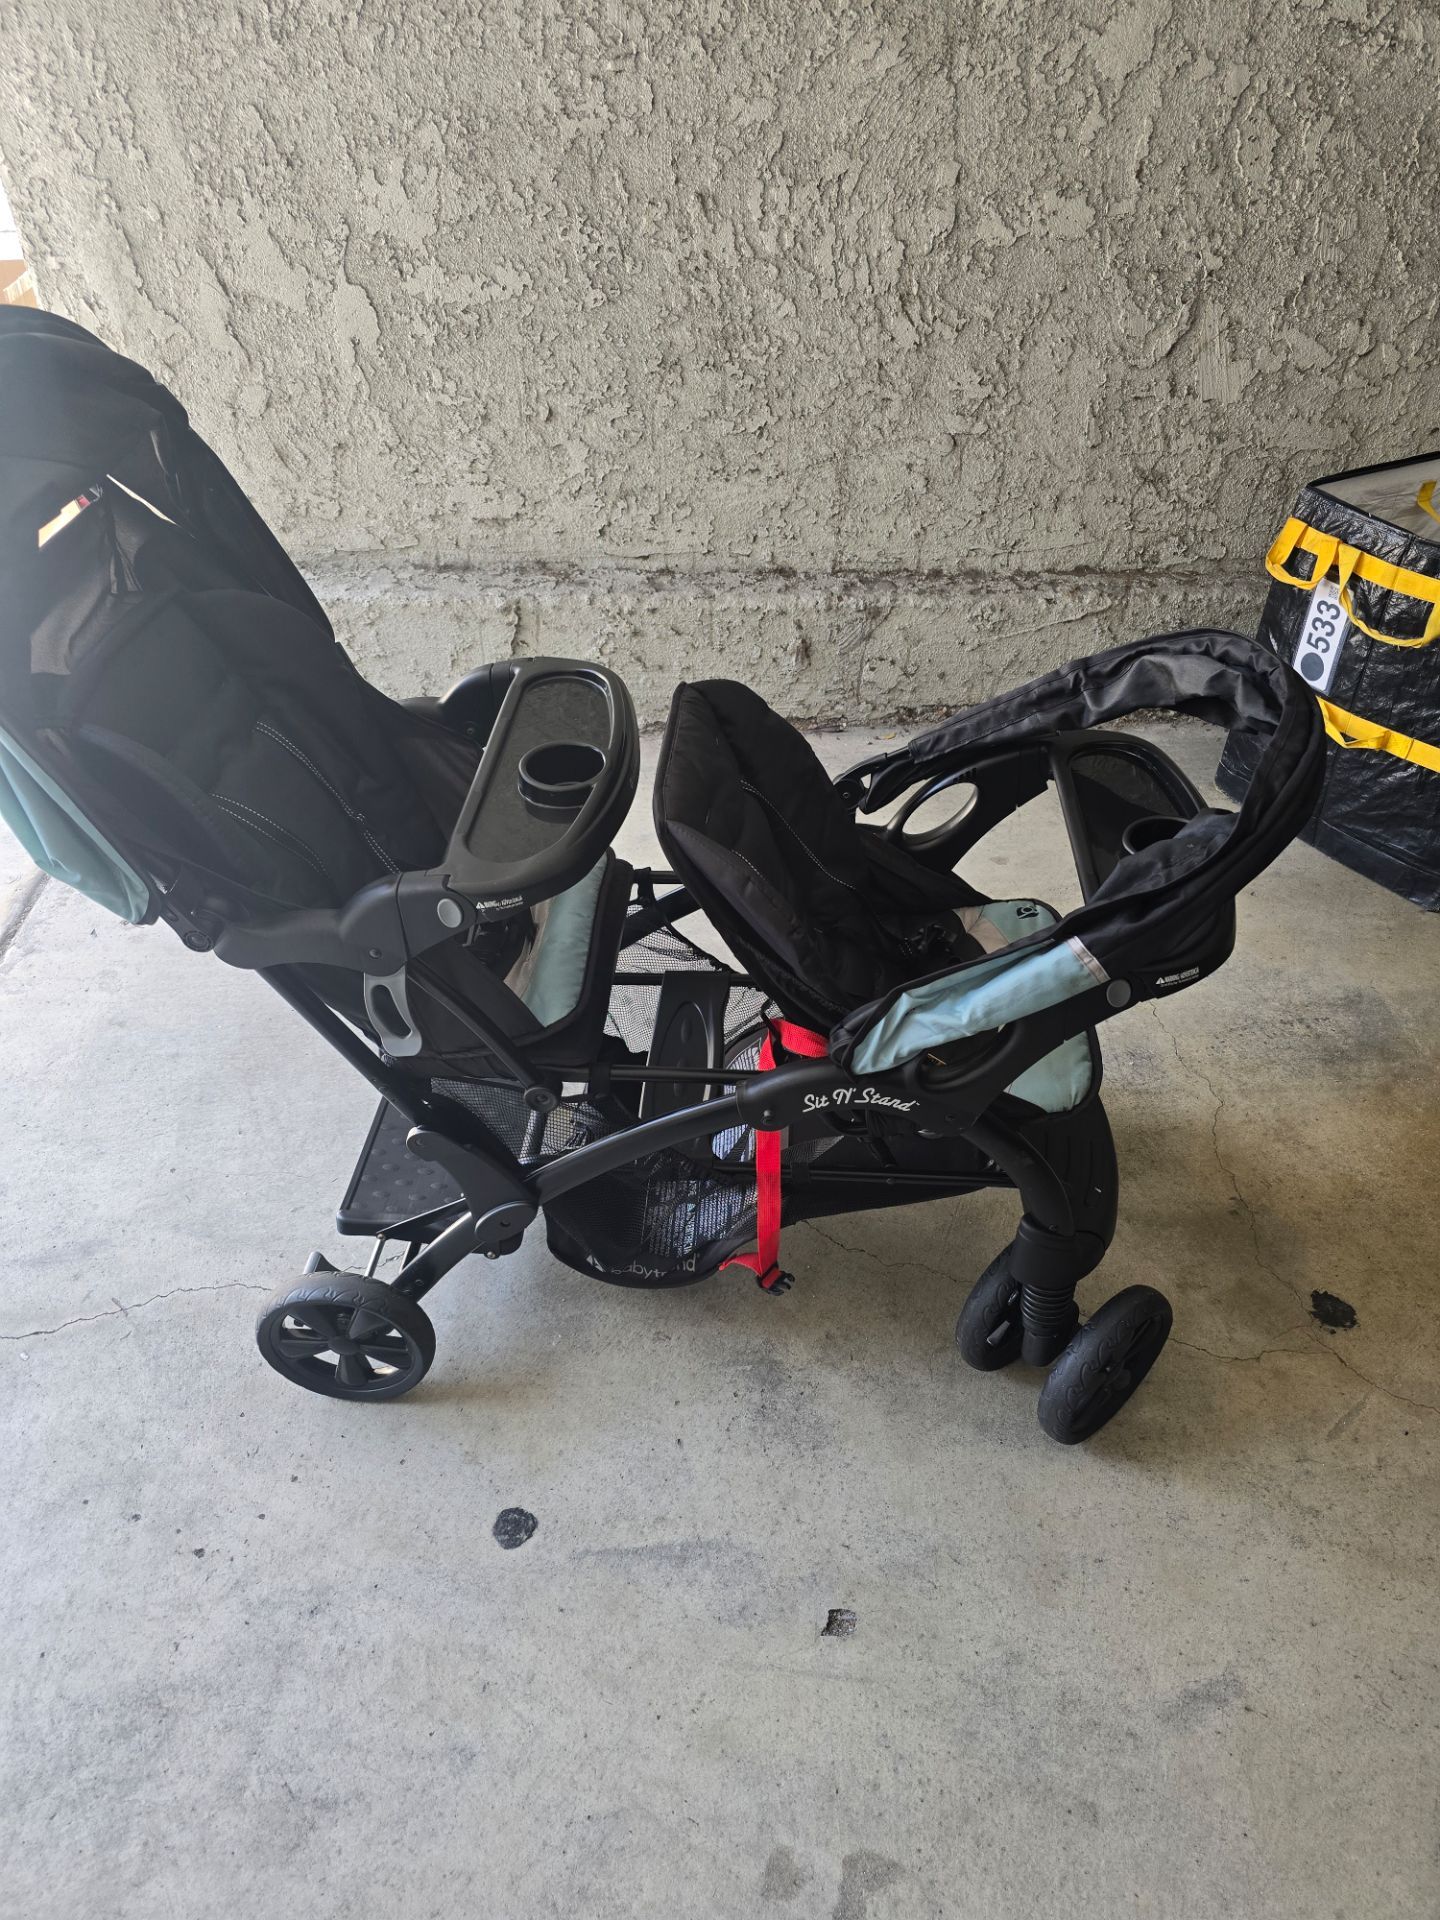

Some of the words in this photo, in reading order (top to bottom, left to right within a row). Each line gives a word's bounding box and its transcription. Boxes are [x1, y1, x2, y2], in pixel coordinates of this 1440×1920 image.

[1306, 600, 1341, 653] 533
[802, 1094, 830, 1113] Sit
[854, 1087, 917, 1112] Stand
